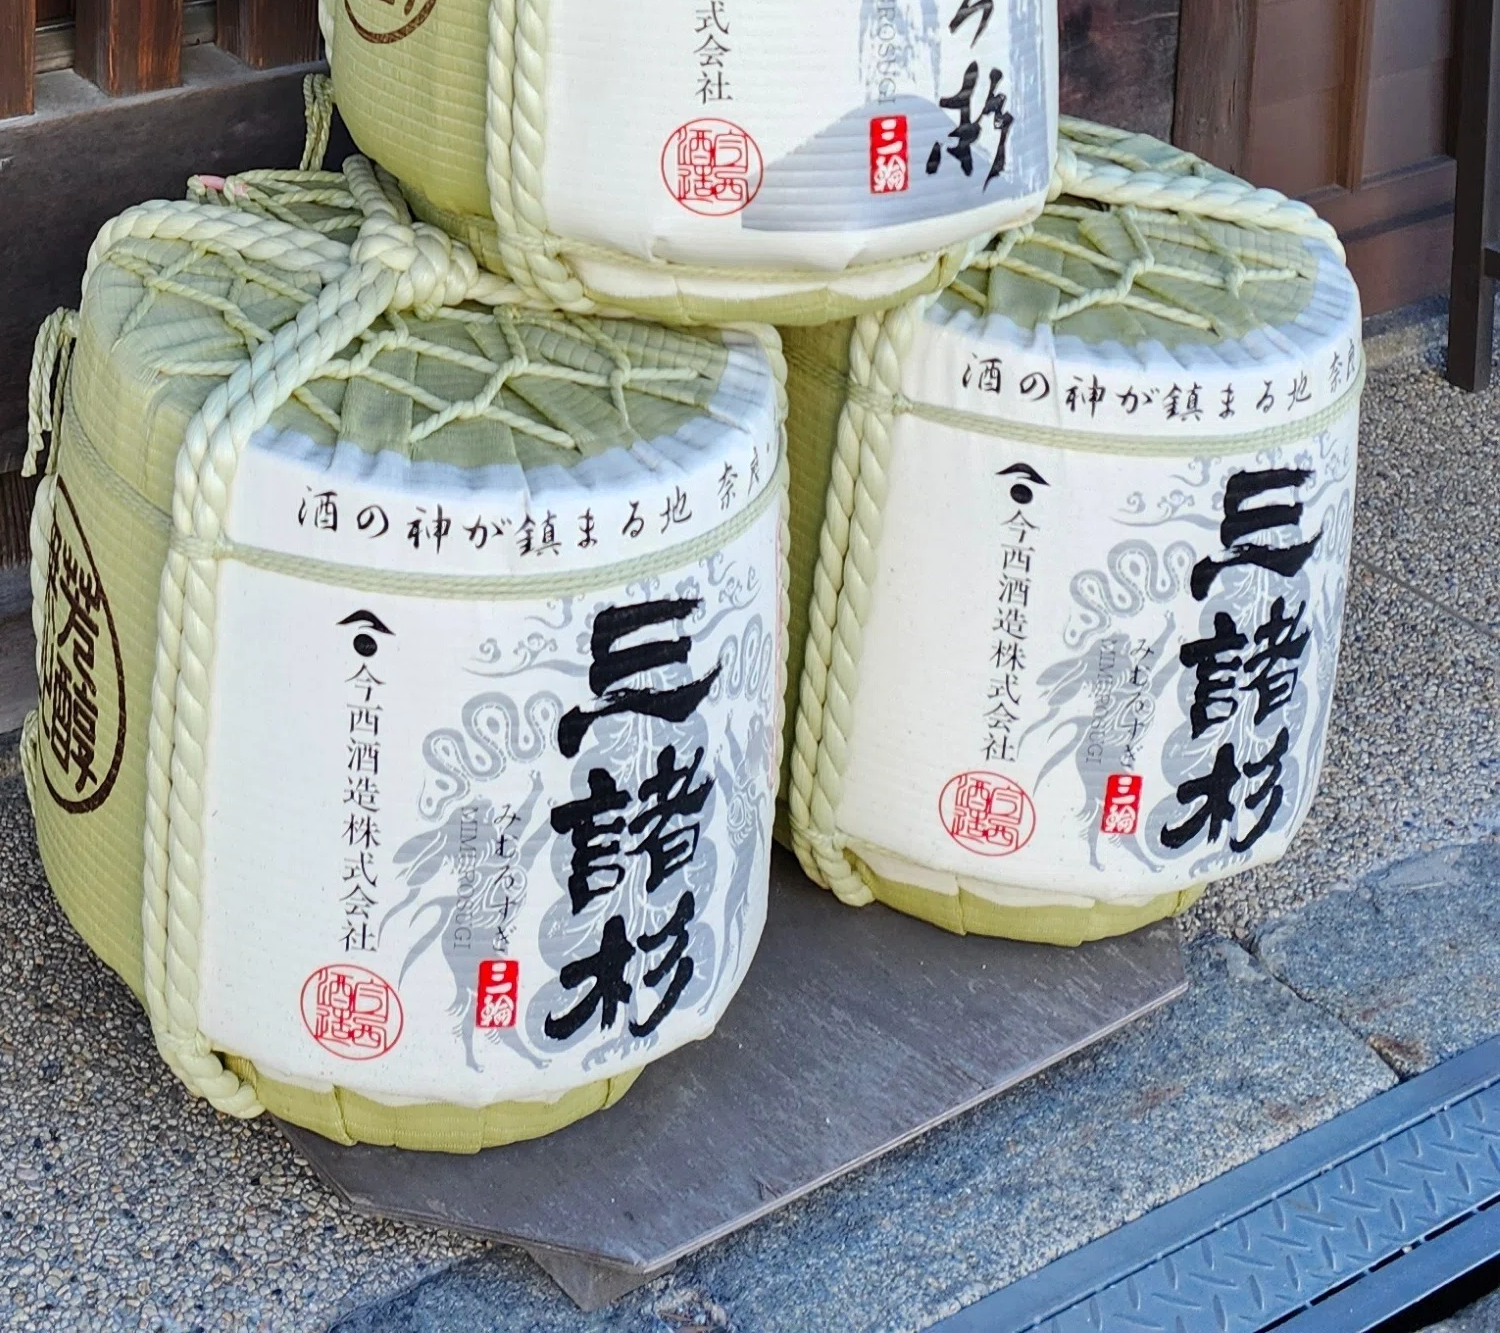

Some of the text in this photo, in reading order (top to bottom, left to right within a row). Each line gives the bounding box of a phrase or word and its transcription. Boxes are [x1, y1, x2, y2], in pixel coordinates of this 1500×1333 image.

[873, 118, 907, 192] 三輪
[980, 509, 1041, 765] 今西酒造株式会社
[1160, 467, 1323, 854] 三諸杉
[338, 660, 387, 954] 今西酒造株式会社
[542, 598, 723, 1046] 三諸杉
